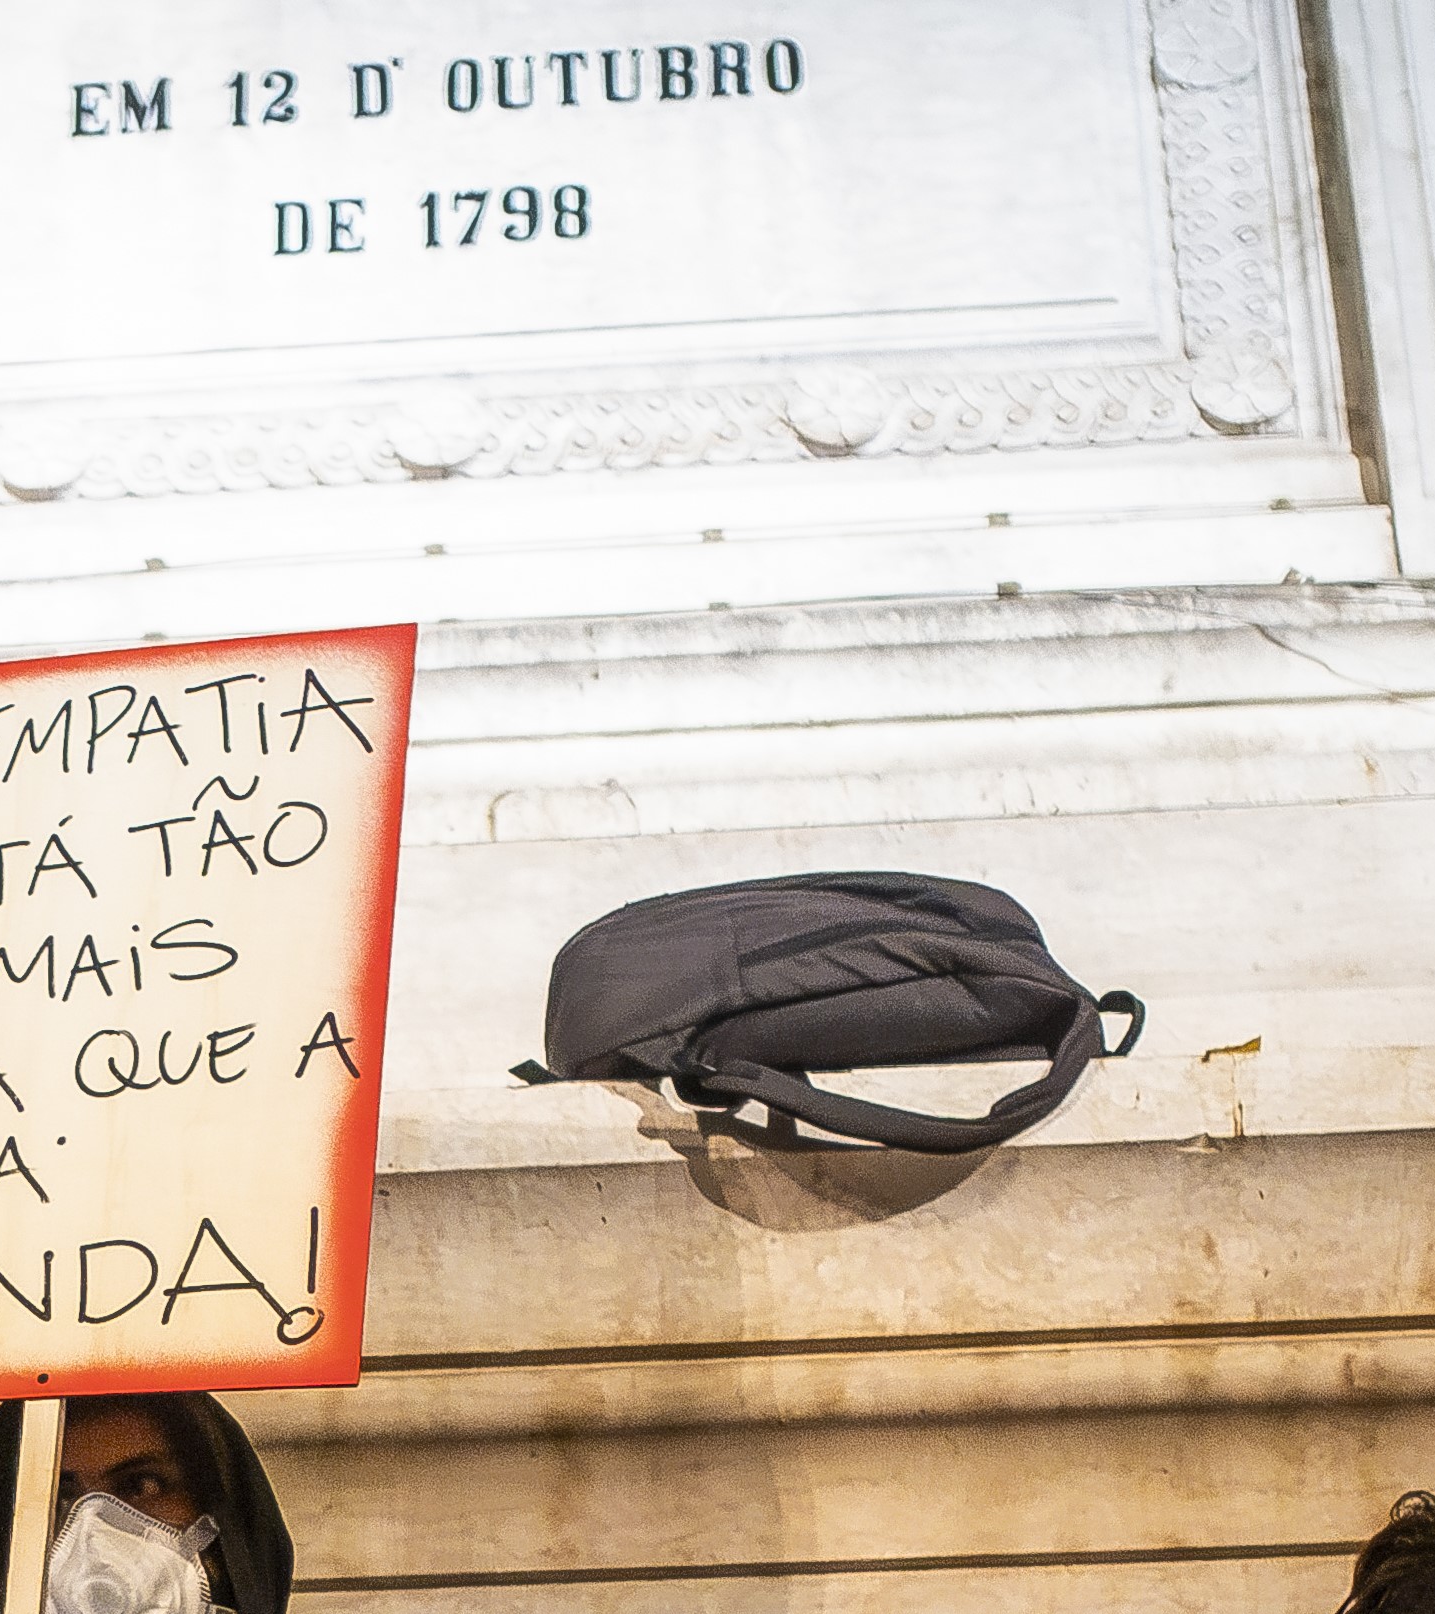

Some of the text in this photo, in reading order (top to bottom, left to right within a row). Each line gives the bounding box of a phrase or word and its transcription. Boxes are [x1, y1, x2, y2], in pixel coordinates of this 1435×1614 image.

[71, 78, 174, 137] EM
[225, 70, 300, 127] 12
[446, 36, 806, 113] OUTUBRO
[273, 184, 592, 256] DE 1798
[129, 776, 327, 876] TÃO
[75, 1022, 258, 1097] QUE
[296, 1012, 360, 1078] A
